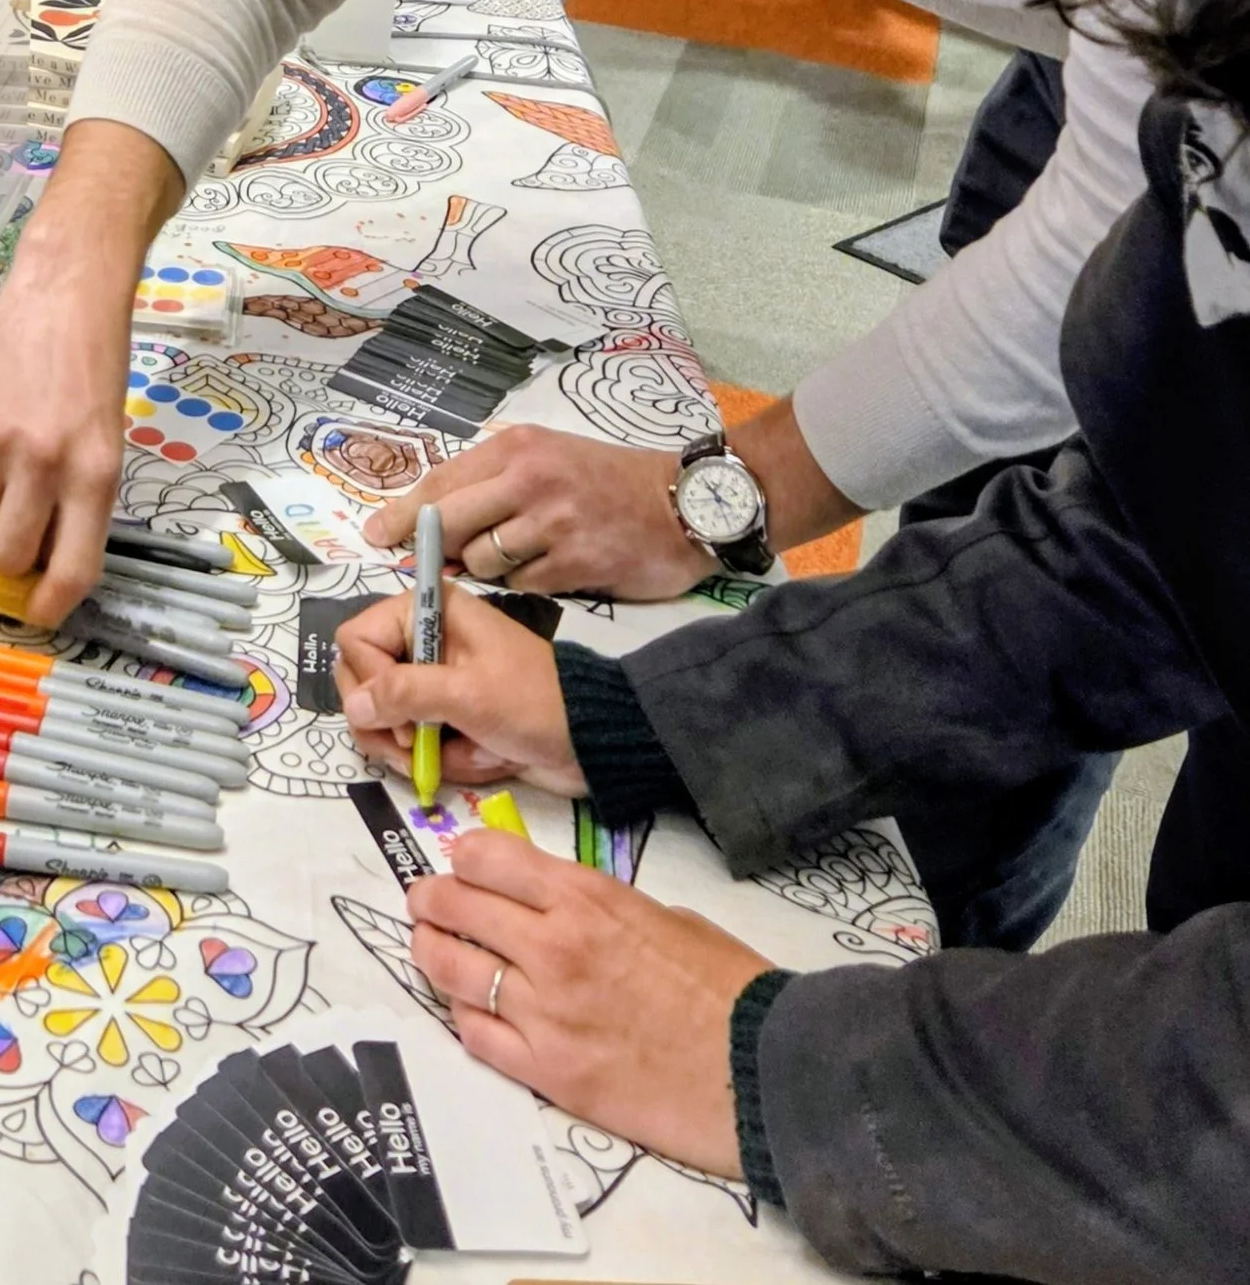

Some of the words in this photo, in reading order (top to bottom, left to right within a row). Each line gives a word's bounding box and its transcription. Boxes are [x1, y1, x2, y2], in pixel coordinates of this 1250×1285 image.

[376, 394, 427, 420] Hello
[250, 510, 285, 541] Hello
[45, 859, 109, 881] Sharpie
[382, 830, 419, 884] Hello
[276, 1109, 342, 1181] Hello
[317, 1107, 382, 1180] Hello
[379, 1102, 418, 1174] Hello
[244, 1147, 318, 1215] Hello
